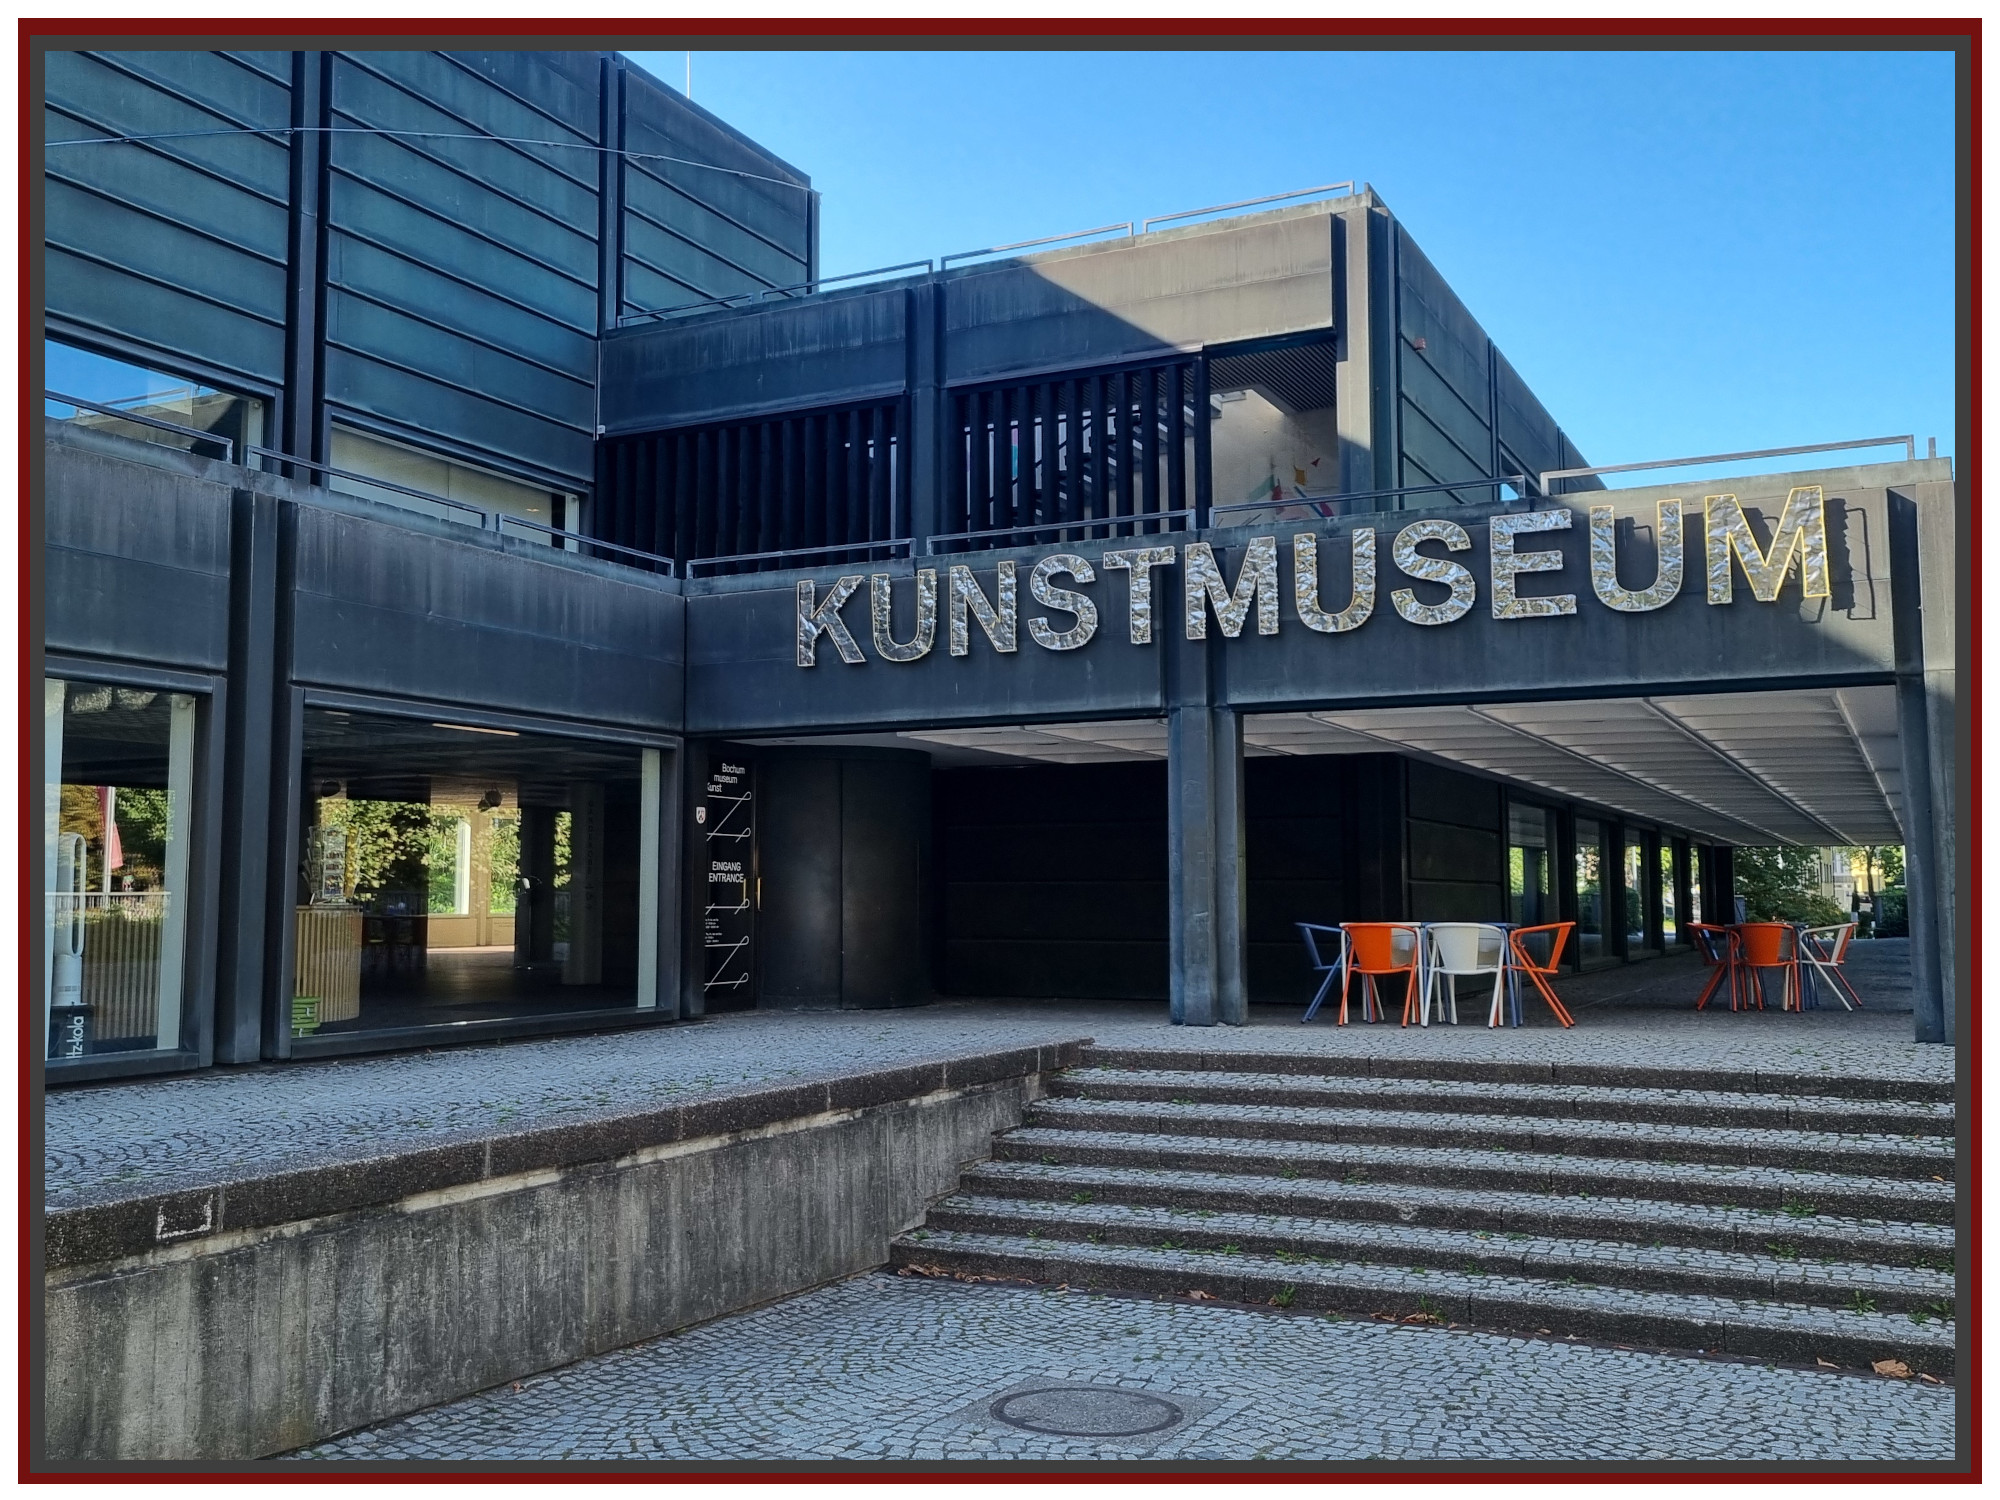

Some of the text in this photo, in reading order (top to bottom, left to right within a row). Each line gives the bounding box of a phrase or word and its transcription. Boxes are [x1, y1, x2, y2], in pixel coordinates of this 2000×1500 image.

[797, 485, 1831, 667] KUNSTMUSEUM
[721, 763, 746, 774] Bochum
[713, 774, 738, 784] museum
[712, 861, 742, 872] EINGANG
[708, 872, 744, 883] ENTRANCE
